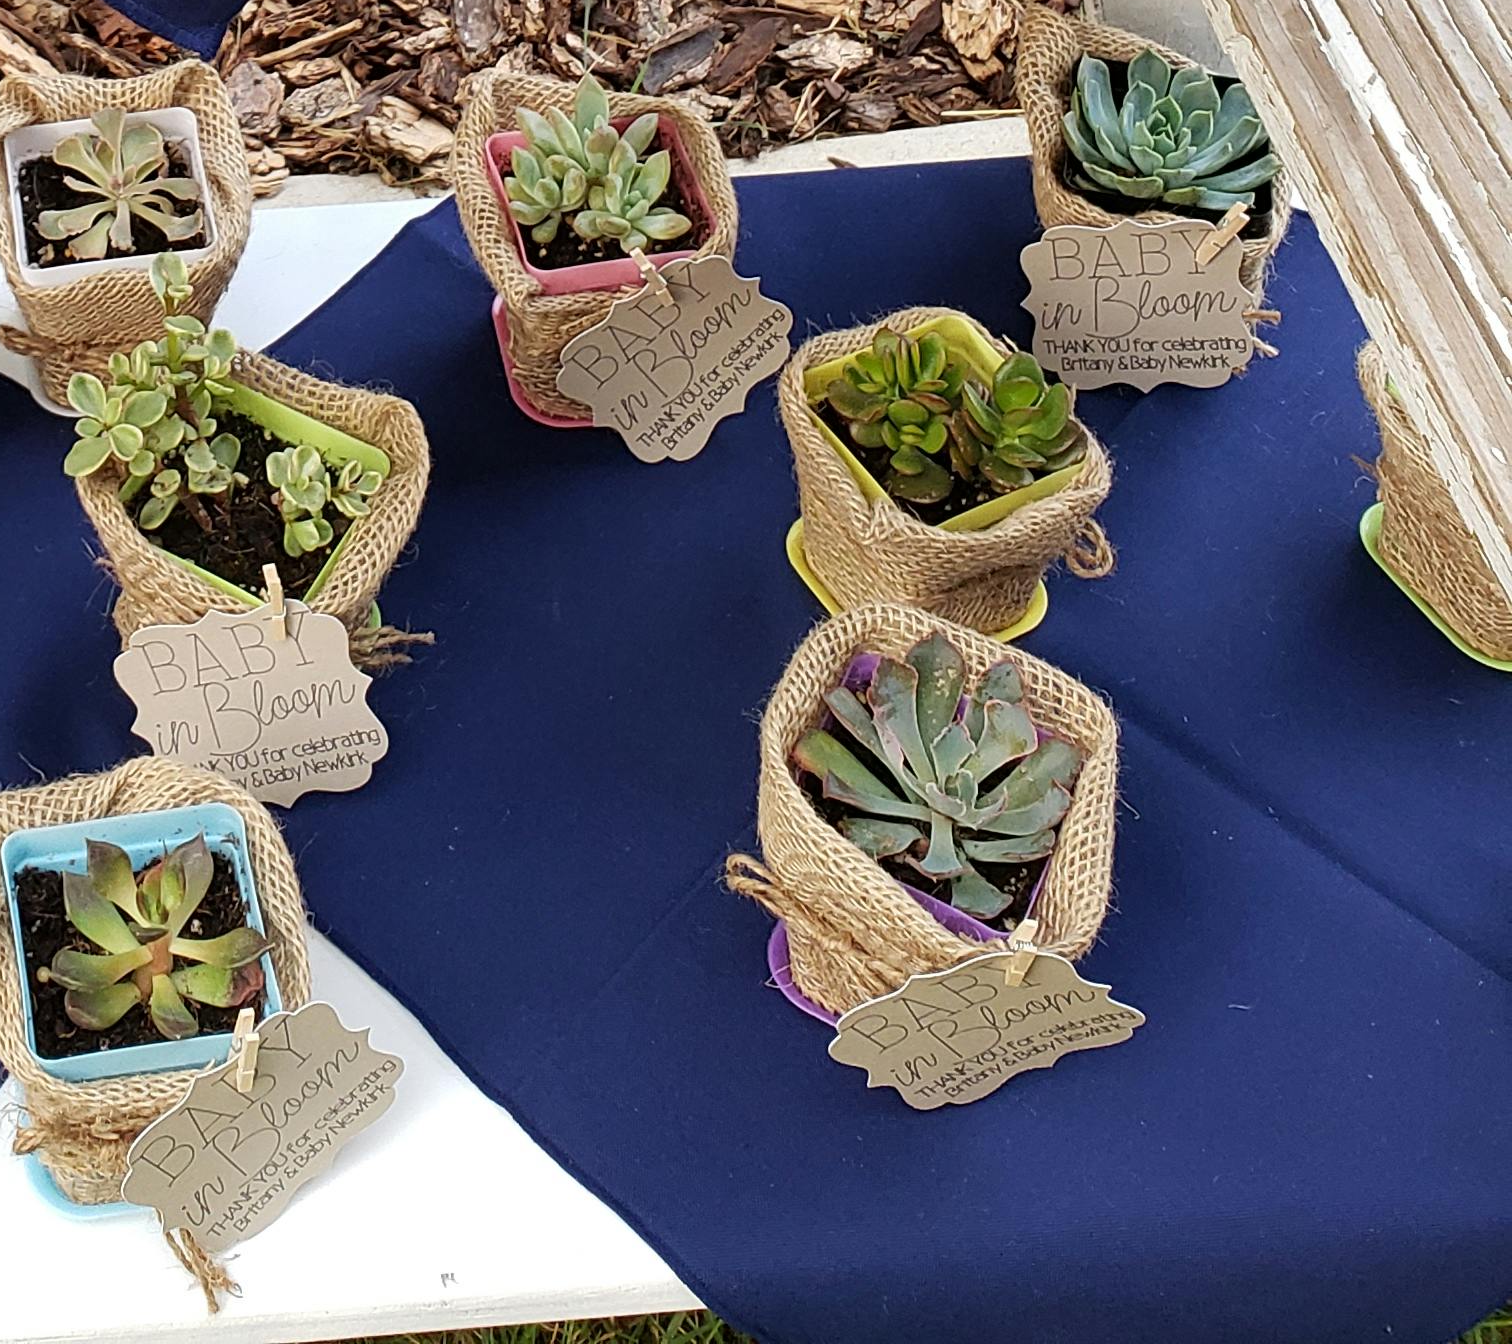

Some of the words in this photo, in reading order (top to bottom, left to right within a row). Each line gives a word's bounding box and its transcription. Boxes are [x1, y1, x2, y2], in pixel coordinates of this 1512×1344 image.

[1045, 229, 1214, 281] BABY
[571, 263, 711, 389] BABY
[1041, 302, 1081, 330] in
[1086, 276, 1237, 339] Bloom
[1043, 339, 1094, 354] THANK
[1098, 338, 1129, 352] YOU
[1133, 339, 1157, 352] for
[1161, 337, 1246, 353] celebrating
[610, 391, 649, 430] in
[633, 289, 751, 408] Bloom
[636, 406, 681, 447] THANK
[675, 382, 703, 411] YOU
[701, 365, 720, 388] for
[721, 309, 785, 368] celebrating
[661, 410, 705, 451] Britany
[701, 399, 713, 411] &
[708, 375, 742, 403] Baby
[736, 330, 784, 379] Newkirk
[1062, 357, 1113, 374] Britany
[1118, 357, 1129, 370] &
[1131, 356, 1170, 372] Baby
[1169, 355, 1231, 369] Newkirk
[133, 611, 314, 695] BABY
[156, 721, 199, 755] in
[203, 679, 356, 756] Bloom
[224, 751, 258, 771] YOU
[261, 748, 287, 763] for
[292, 728, 380, 757] celebrating
[252, 772, 264, 787] &
[264, 766, 301, 786] Baby
[304, 750, 369, 776] Newkirk
[891, 1052, 937, 1087] in
[928, 988, 1095, 1064] Bloom
[132, 1018, 312, 1187] BABY
[182, 1176, 224, 1226] in
[212, 1042, 359, 1190] Bloom
[207, 1184, 259, 1236] THANK
[254, 1152, 288, 1183] YOU
[287, 1130, 311, 1153] for
[315, 1060, 396, 1129] celebrating
[234, 1178, 285, 1232] Britany
[284, 1168, 298, 1178] &
[294, 1134, 332, 1168] Baby
[329, 1084, 390, 1135] Newkirk
